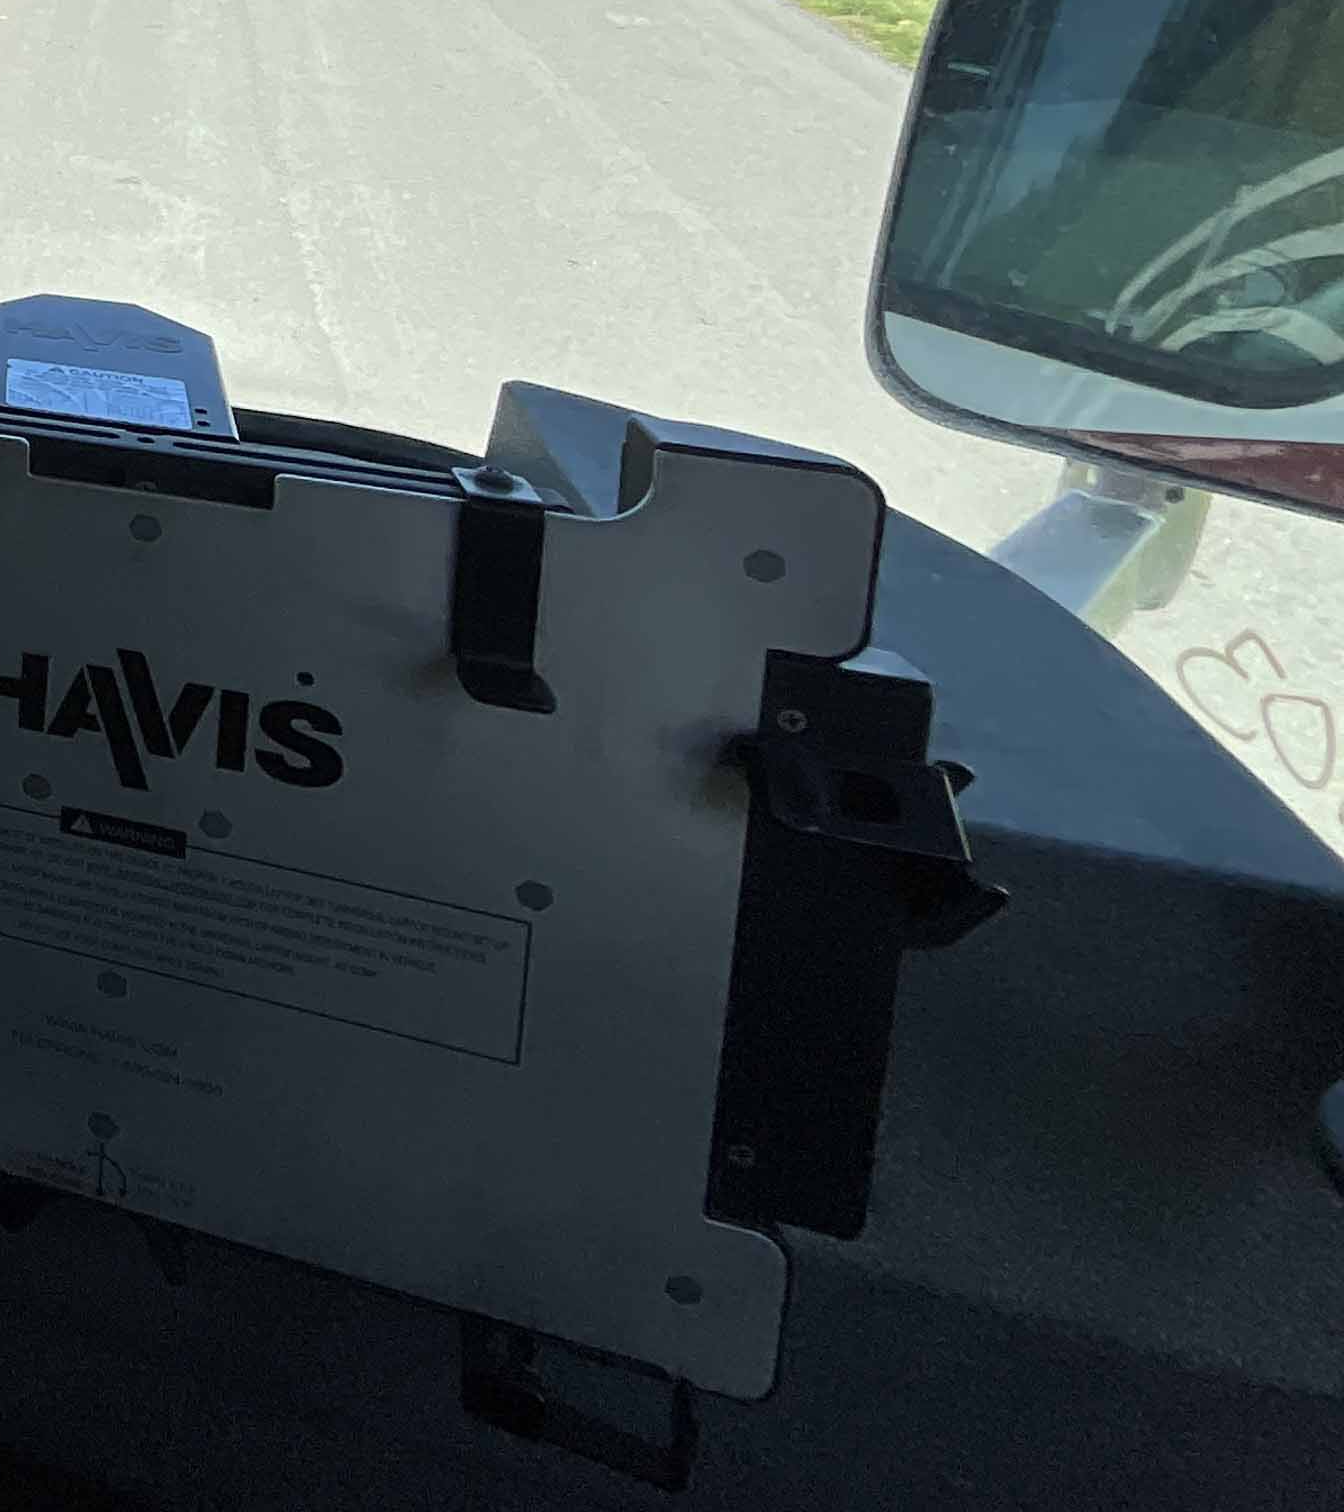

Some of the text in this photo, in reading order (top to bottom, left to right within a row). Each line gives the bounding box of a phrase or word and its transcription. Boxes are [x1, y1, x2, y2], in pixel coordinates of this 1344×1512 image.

[4, 316, 184, 354] HAVIS
[69, 367, 145, 385] CAUTION
[97, 823, 176, 851] WARNING
